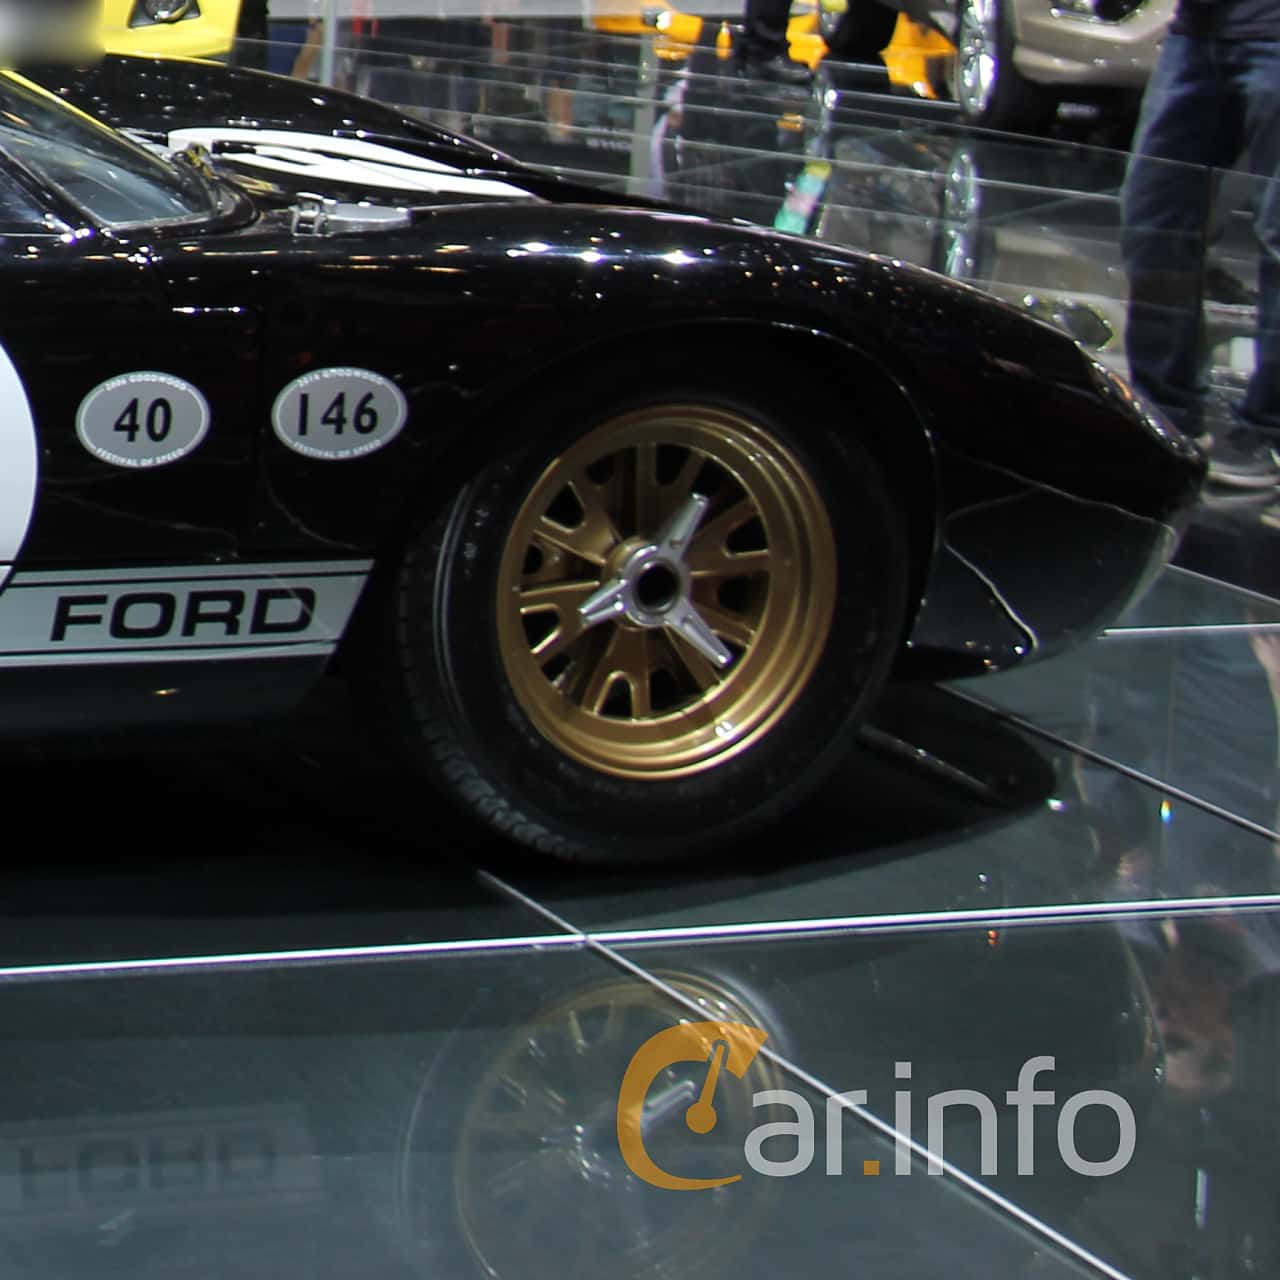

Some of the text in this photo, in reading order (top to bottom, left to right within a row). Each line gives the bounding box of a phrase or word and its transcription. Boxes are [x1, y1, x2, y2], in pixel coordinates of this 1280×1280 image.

[128, 373, 188, 391] GOODWOOD
[113, 397, 172, 443] 40
[298, 391, 378, 436] 146
[50, 587, 316, 642] FORD
